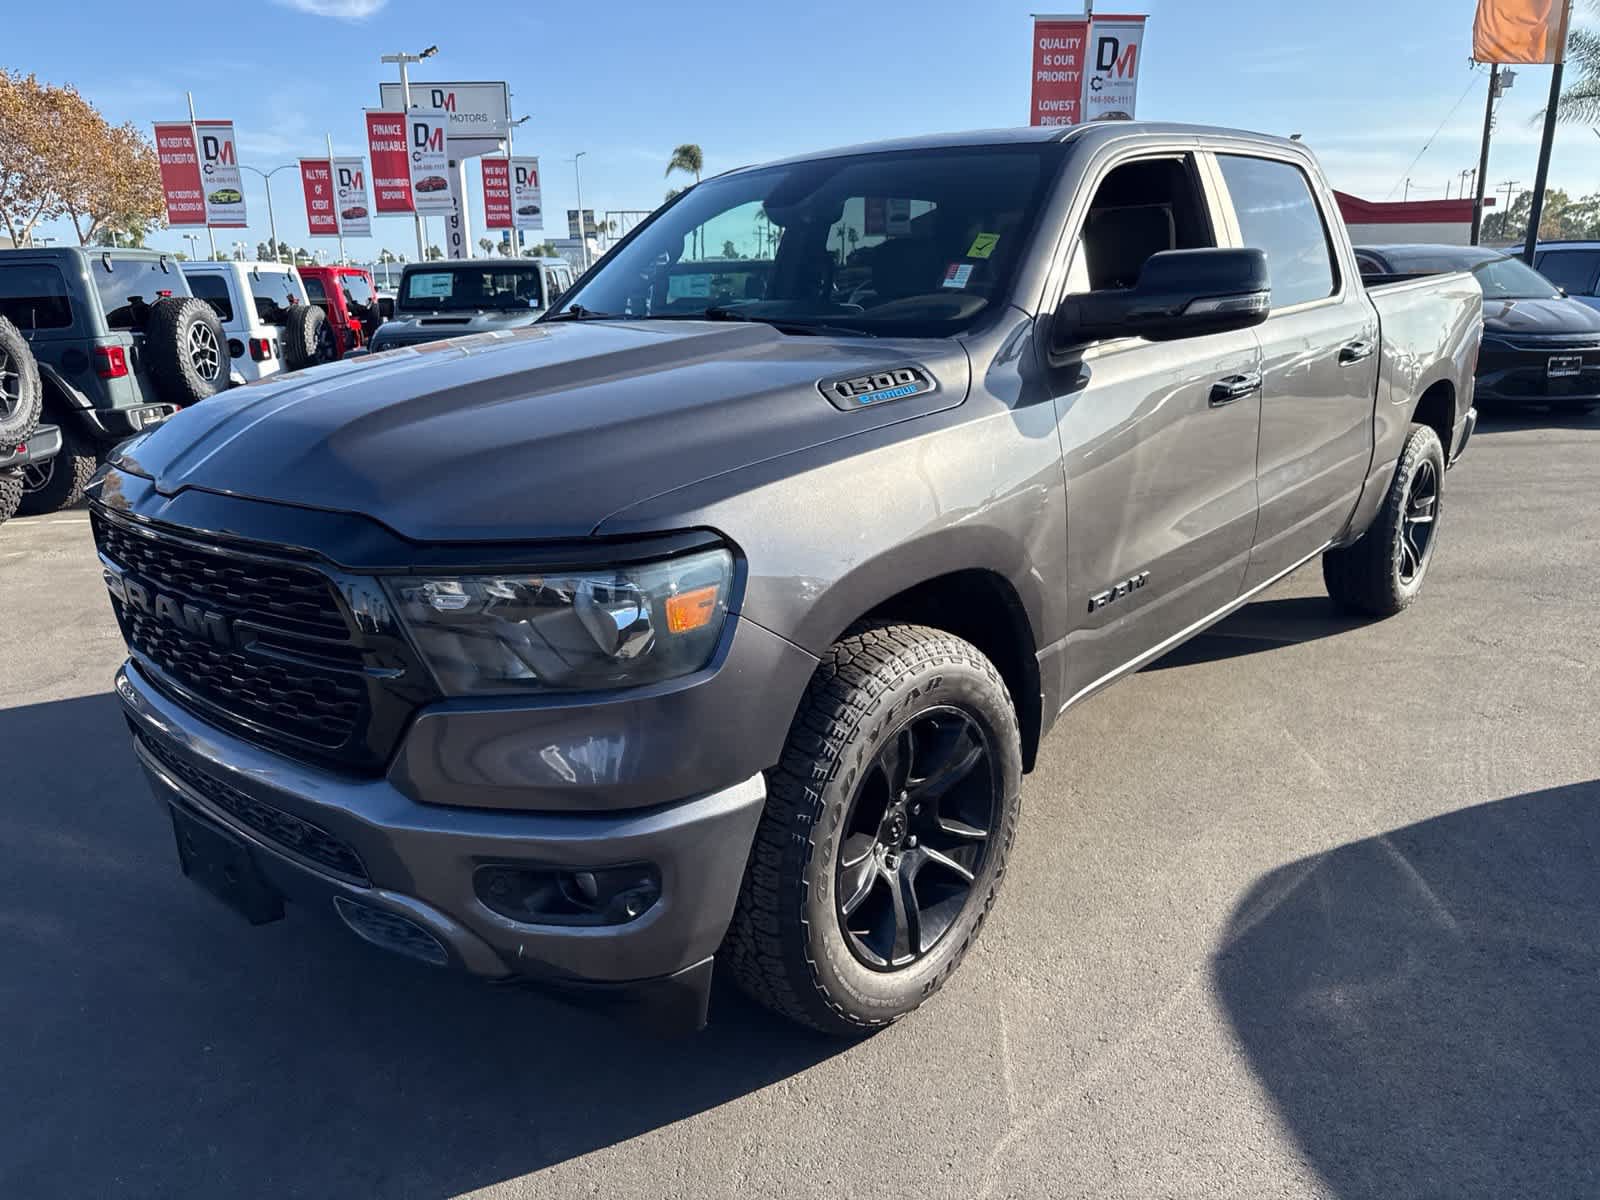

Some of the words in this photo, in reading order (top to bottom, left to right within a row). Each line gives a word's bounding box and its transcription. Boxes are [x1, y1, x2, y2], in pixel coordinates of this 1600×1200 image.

[1039, 37, 1081, 50] QUALITY
[1043, 55, 1053, 66] IS
[1053, 55, 1075, 66] OUR
[1036, 70, 1080, 83] PRIORITY
[1038, 100, 1076, 111] LOWEST
[449, 112, 489, 122] MOTORS
[1040, 116, 1073, 127] PRICES
[372, 124, 402, 136] FINANCE
[371, 140, 407, 152] AVAILABLE
[494, 166, 507, 175] BUY
[486, 189, 509, 198] TRUCKS
[311, 199, 329, 210] CREDIT
[310, 215, 335, 225] WELCOME
[833, 368, 916, 396] 1500
[1087, 570, 1151, 614] RAM
[124, 575, 232, 649] RAM
